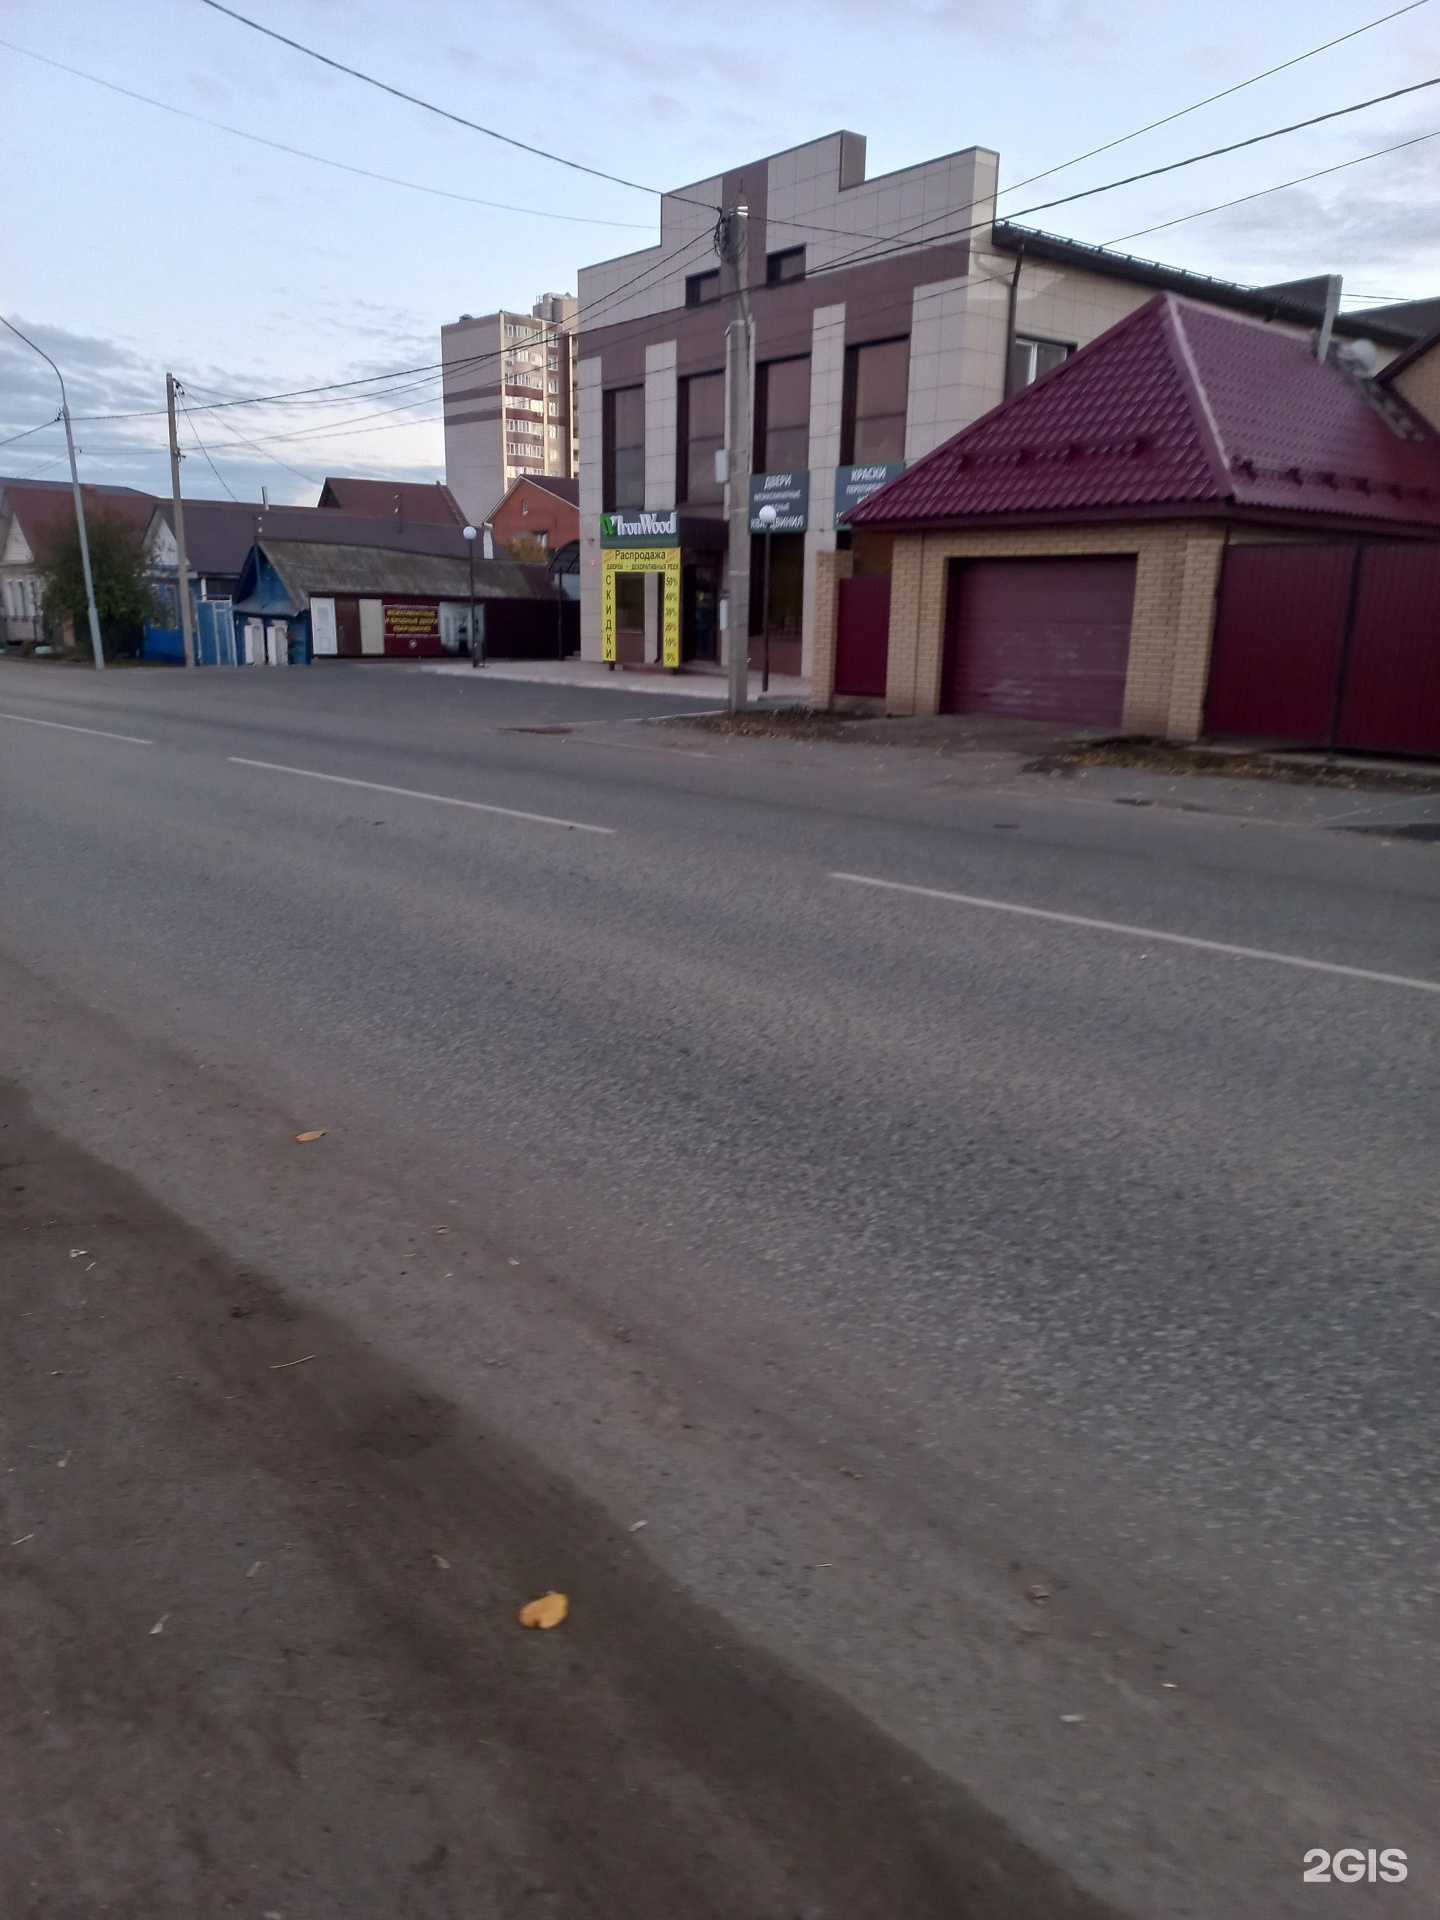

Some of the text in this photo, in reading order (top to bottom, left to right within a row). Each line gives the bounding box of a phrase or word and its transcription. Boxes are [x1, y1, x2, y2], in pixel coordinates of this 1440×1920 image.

[851, 466, 886, 481] КРАСКИ
[764, 474, 791, 490] ДВЕРИ
[615, 550, 666, 563] Распродажа
[605, 574, 613, 660] СКИДКИ
